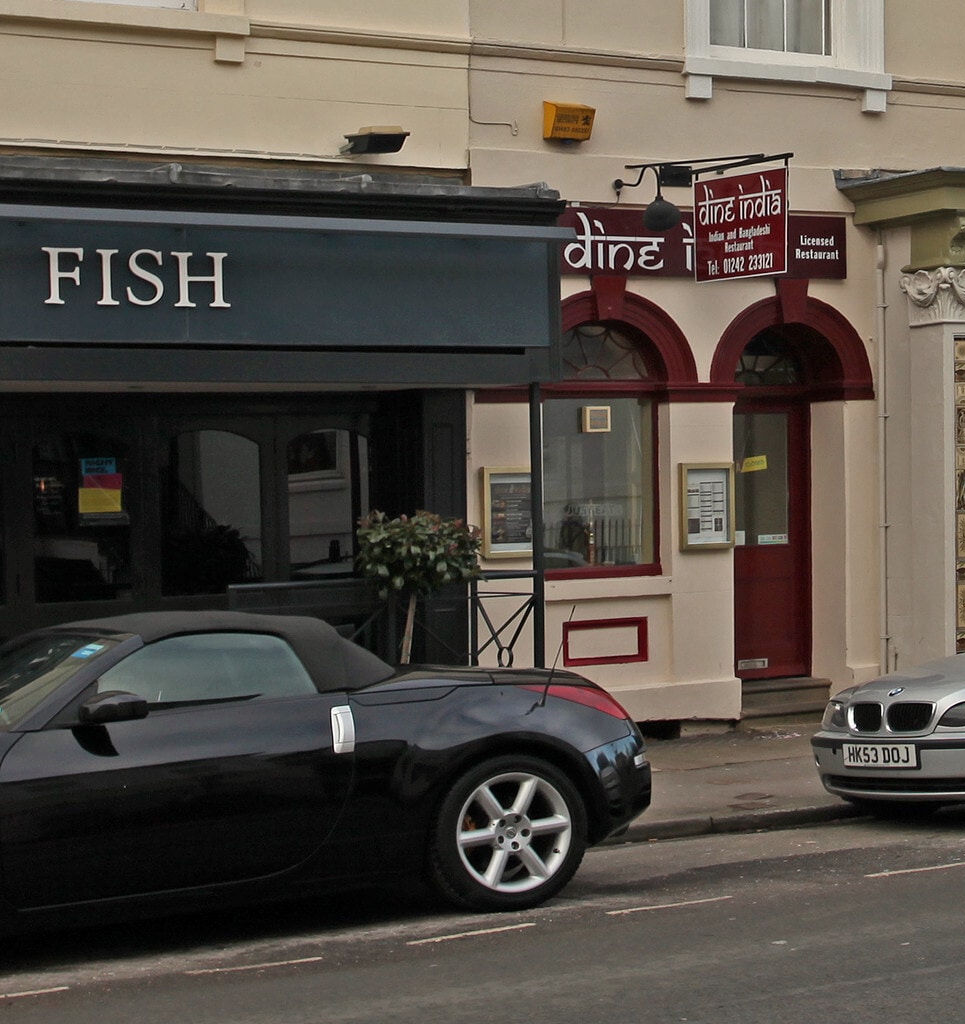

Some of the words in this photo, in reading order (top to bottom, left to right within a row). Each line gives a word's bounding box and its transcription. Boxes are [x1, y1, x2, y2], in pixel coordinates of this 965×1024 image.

[698, 184, 735, 225] dine
[739, 175, 782, 220] india
[563, 212, 665, 271] dine
[709, 231, 725, 242] Indian
[727, 228, 737, 239] and
[739, 223, 771, 239] Bangladeshi
[800, 235, 835, 246] Licensed
[724, 239, 754, 253] Restaurant
[795, 248, 839, 260] Restaurant
[707, 261, 720, 275] Tel:
[723, 257, 745, 274] 01242
[748, 253, 773, 270] 233121
[41, 246, 232, 308] FISH
[848, 746, 879, 763] HK53
[882, 746, 910, 763] DOJ
